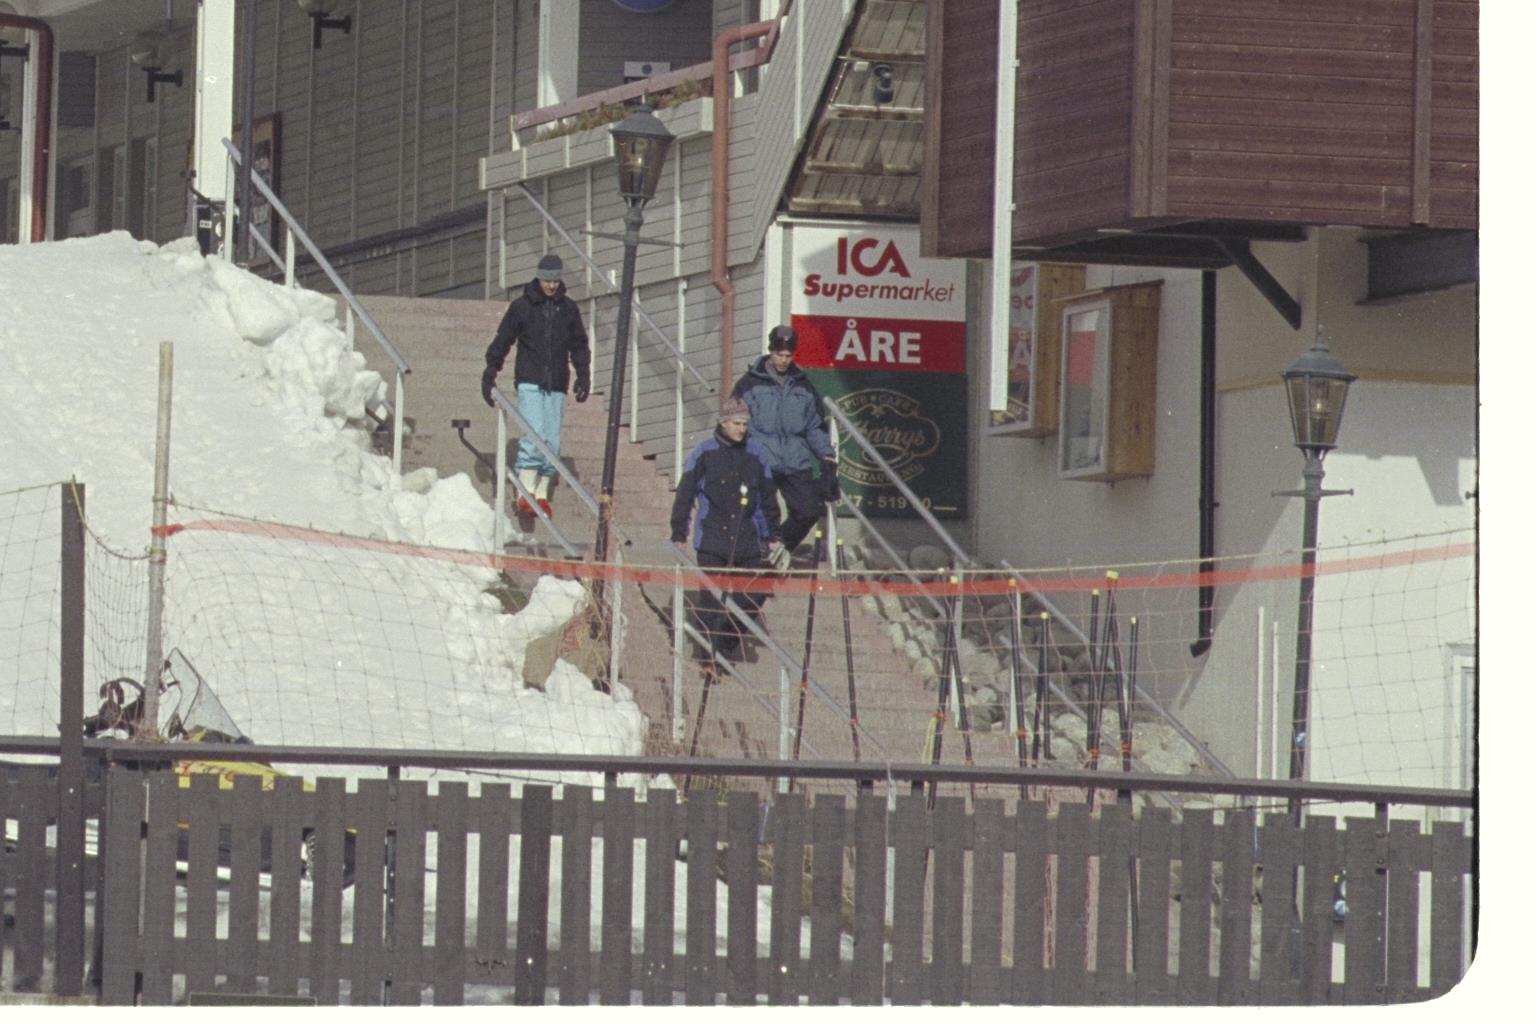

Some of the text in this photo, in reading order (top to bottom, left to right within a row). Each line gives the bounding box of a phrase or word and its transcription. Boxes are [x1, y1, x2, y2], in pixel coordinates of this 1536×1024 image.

[837, 236, 911, 278] ICA
[803, 274, 955, 302] Supermarket
[835, 318, 921, 364] ÅRE
[838, 462, 923, 483] RESTAUNG
[878, 495, 907, 509] 519
